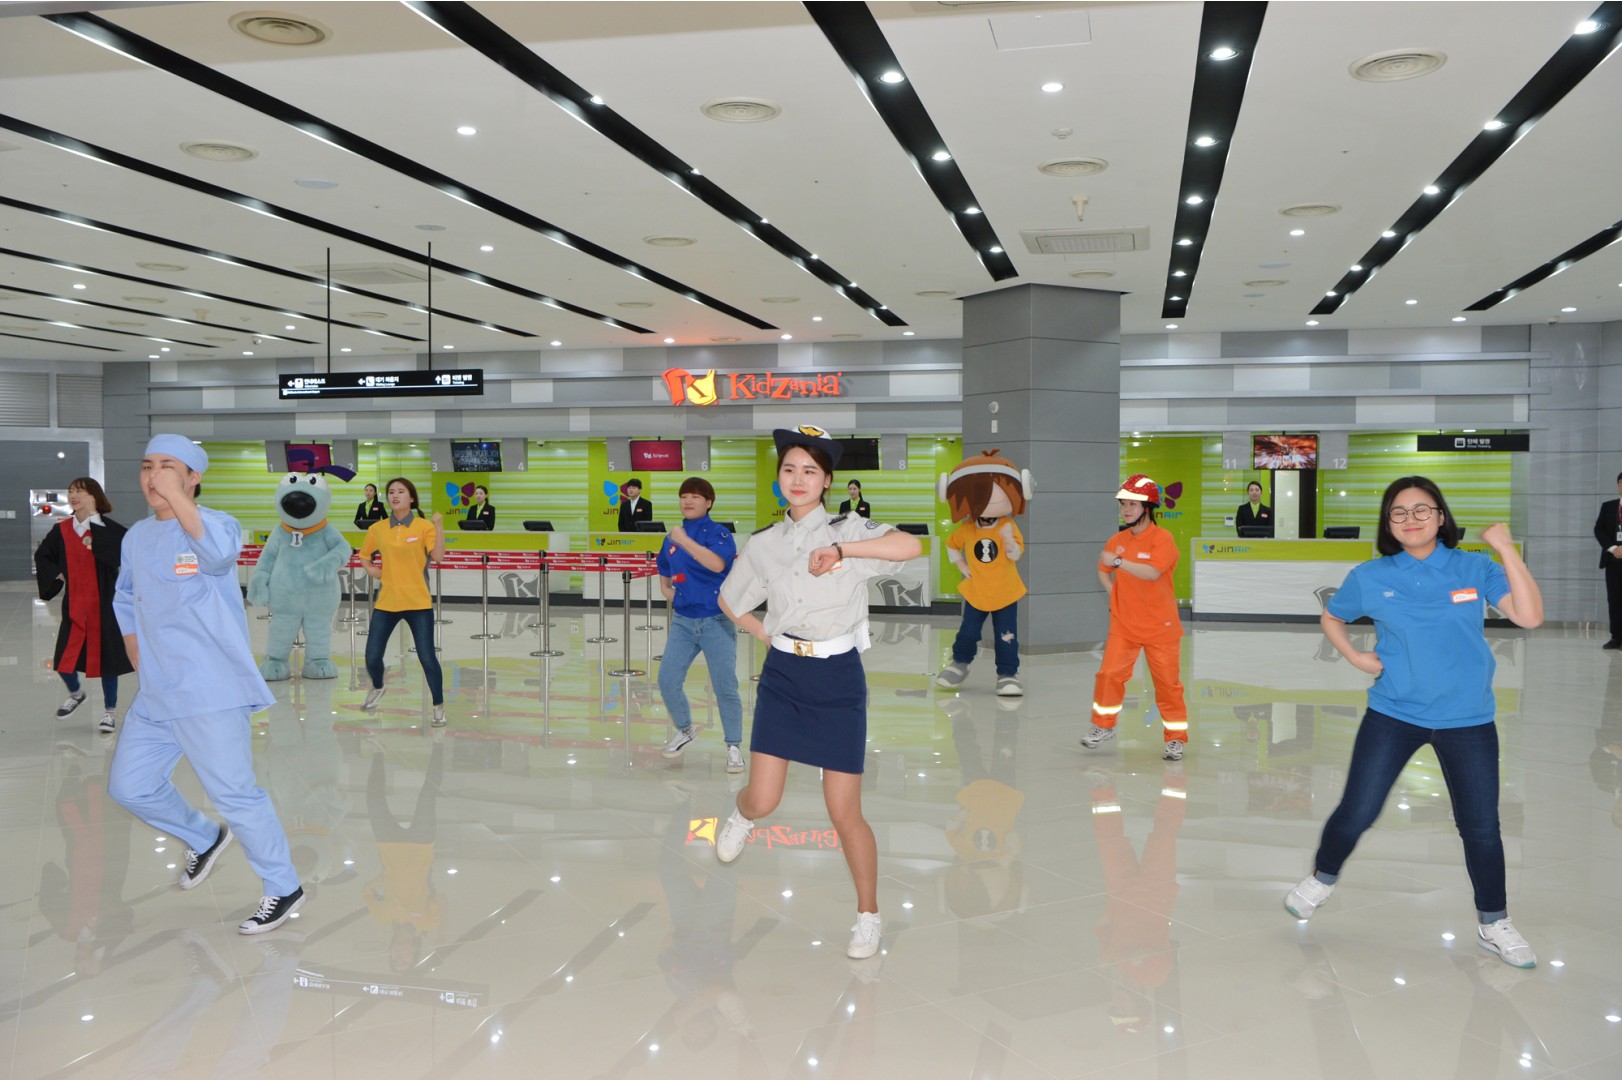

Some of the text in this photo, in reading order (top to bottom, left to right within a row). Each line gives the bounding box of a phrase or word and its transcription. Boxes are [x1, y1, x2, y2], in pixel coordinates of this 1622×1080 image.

[269, 464, 273, 472] 1
[432, 463, 438, 471] 3
[518, 462, 524, 471] 4
[609, 462, 614, 471] 5
[702, 461, 708, 471] 6
[899, 460, 905, 470] 8
[1225, 459, 1237, 469] 11
[1333, 458, 1347, 469] 12
